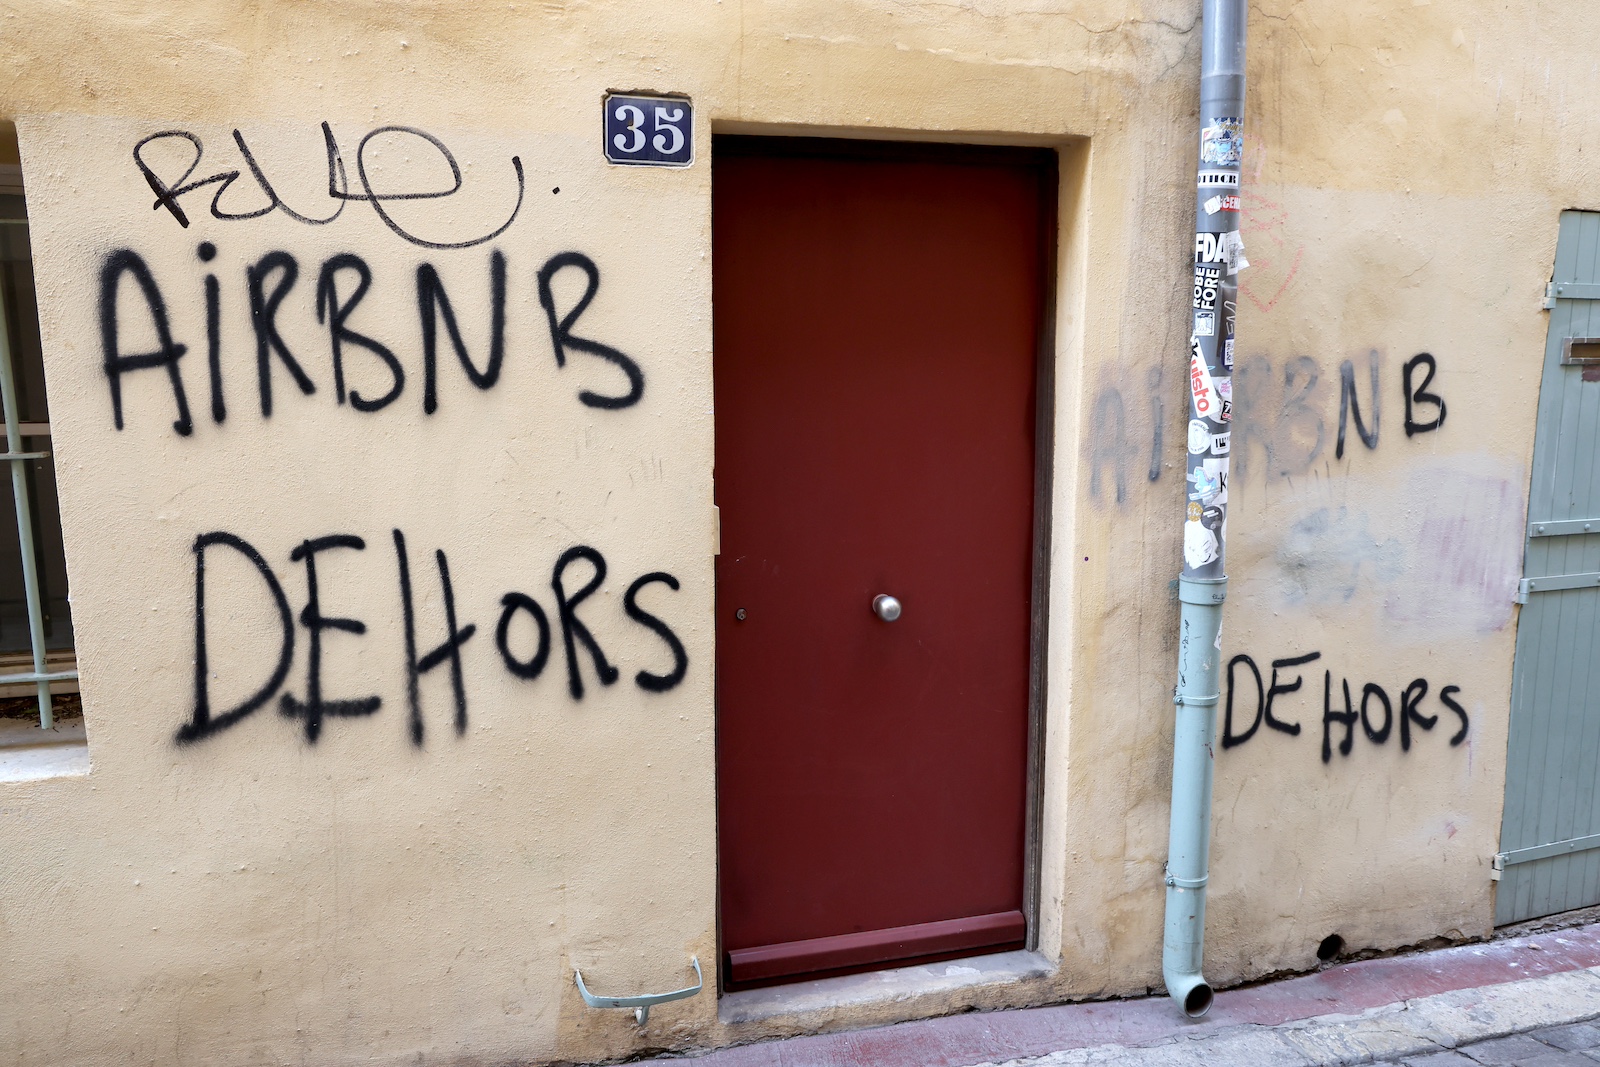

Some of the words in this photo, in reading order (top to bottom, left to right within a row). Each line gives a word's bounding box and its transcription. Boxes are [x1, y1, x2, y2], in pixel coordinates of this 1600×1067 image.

[613, 104, 685, 155] 35
[174, 528, 689, 748] DEHORS
[1222, 651, 1469, 763] DEHORS
